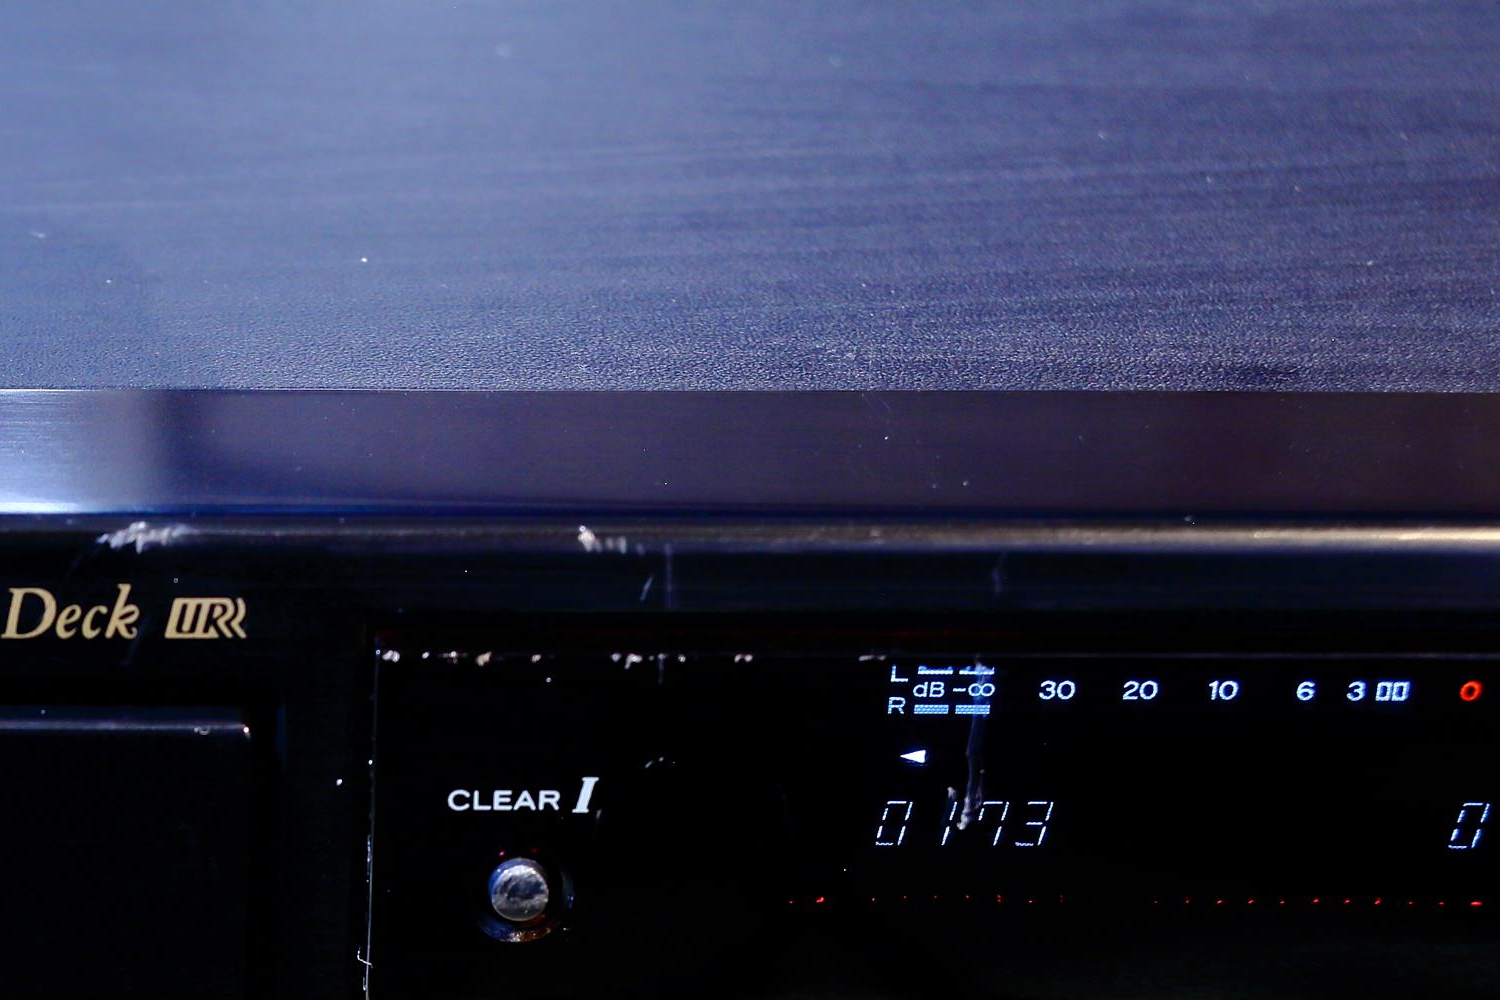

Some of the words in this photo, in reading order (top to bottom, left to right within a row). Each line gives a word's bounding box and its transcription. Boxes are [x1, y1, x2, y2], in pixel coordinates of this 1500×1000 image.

[1, 583, 140, 640] Deck
[890, 665, 909, 683] L
[912, 680, 945, 698] dB
[1038, 679, 1076, 701] 30
[1122, 679, 1159, 701] 20
[1208, 680, 1240, 701] 10
[1295, 680, 1317, 702] 6
[1346, 679, 1367, 702] 3
[1459, 680, 1482, 702] 0
[887, 696, 906, 715] R
[447, 789, 561, 812] CLEAR
[875, 798, 1054, 847] 0173
[1447, 802, 1491, 850] 0
